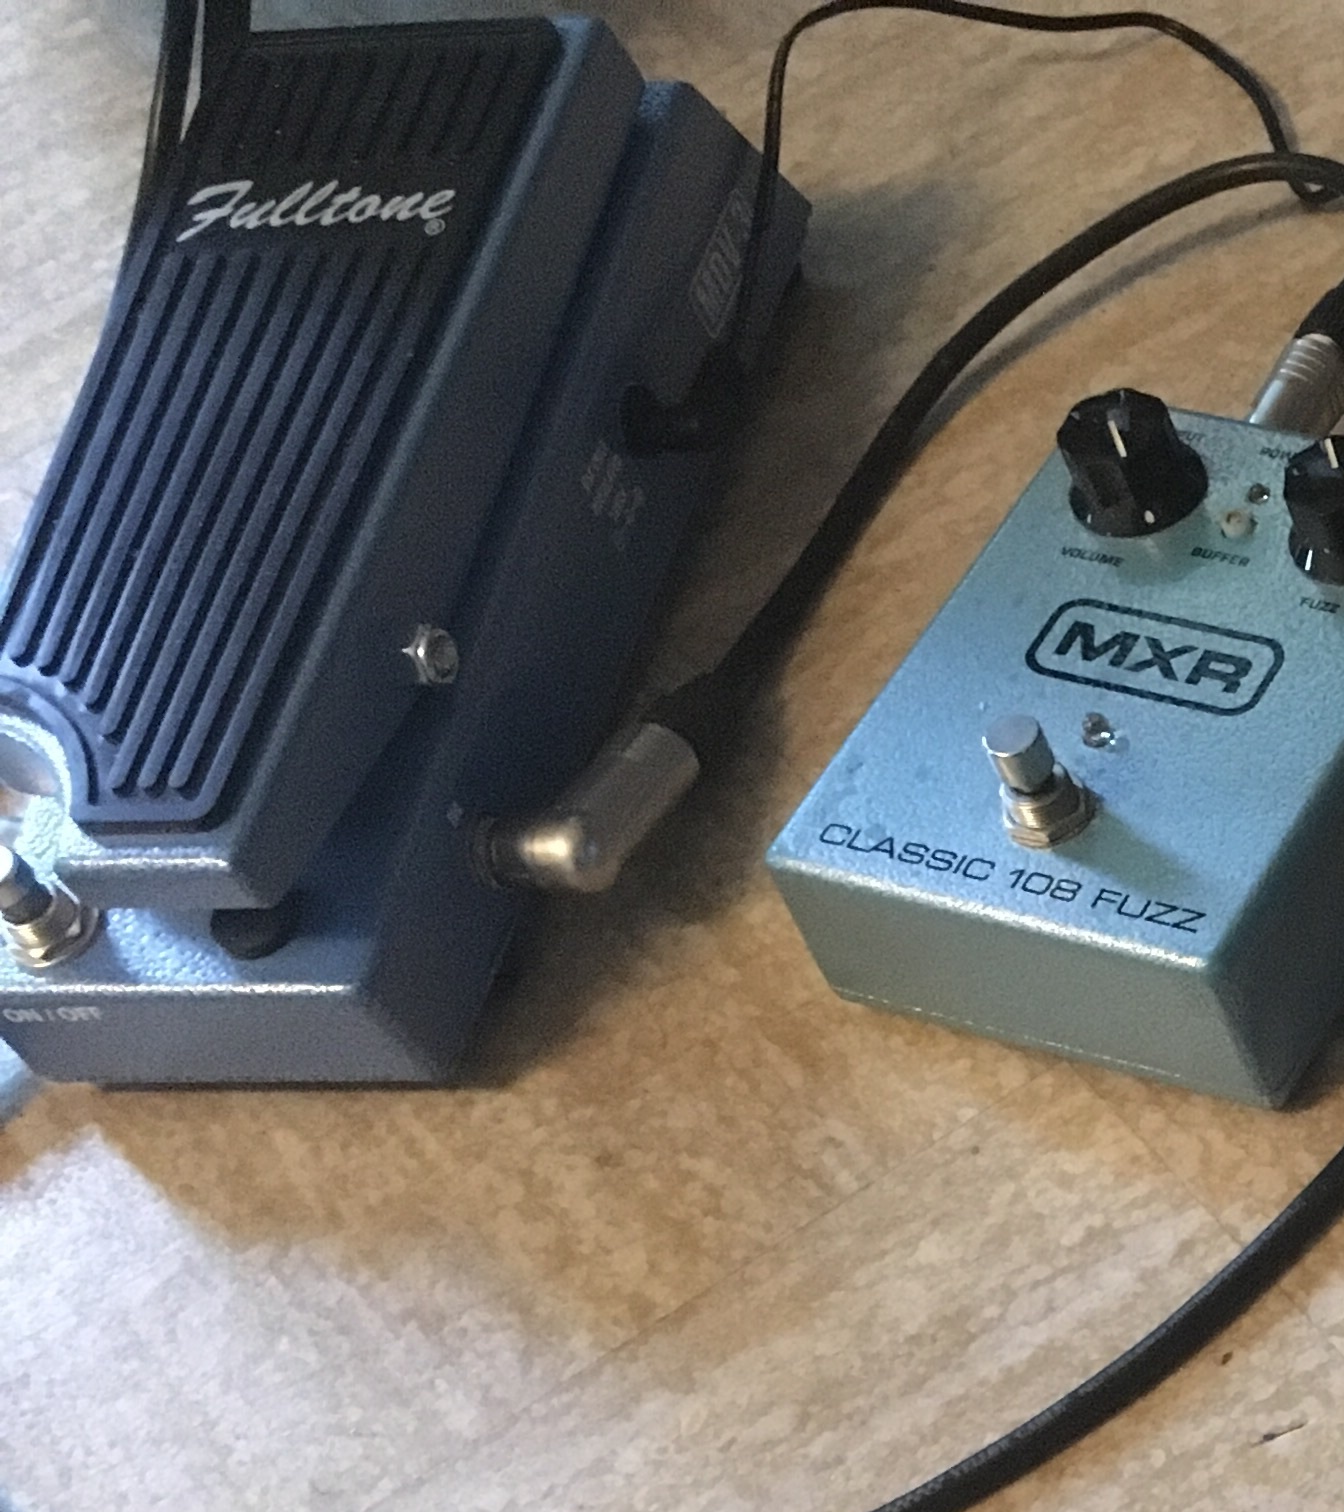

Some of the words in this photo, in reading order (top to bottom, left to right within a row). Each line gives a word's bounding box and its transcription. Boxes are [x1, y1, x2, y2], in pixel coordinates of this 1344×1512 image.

[1061, 546, 1125, 567] VOLUME
[1190, 546, 1251, 567] BUFFER
[1300, 597, 1341, 615] FUZZ
[1053, 620, 1254, 694] MXR
[818, 823, 997, 882] CLASSIC
[1008, 868, 1082, 903] 108
[1090, 887, 1207, 934] FUZZ
